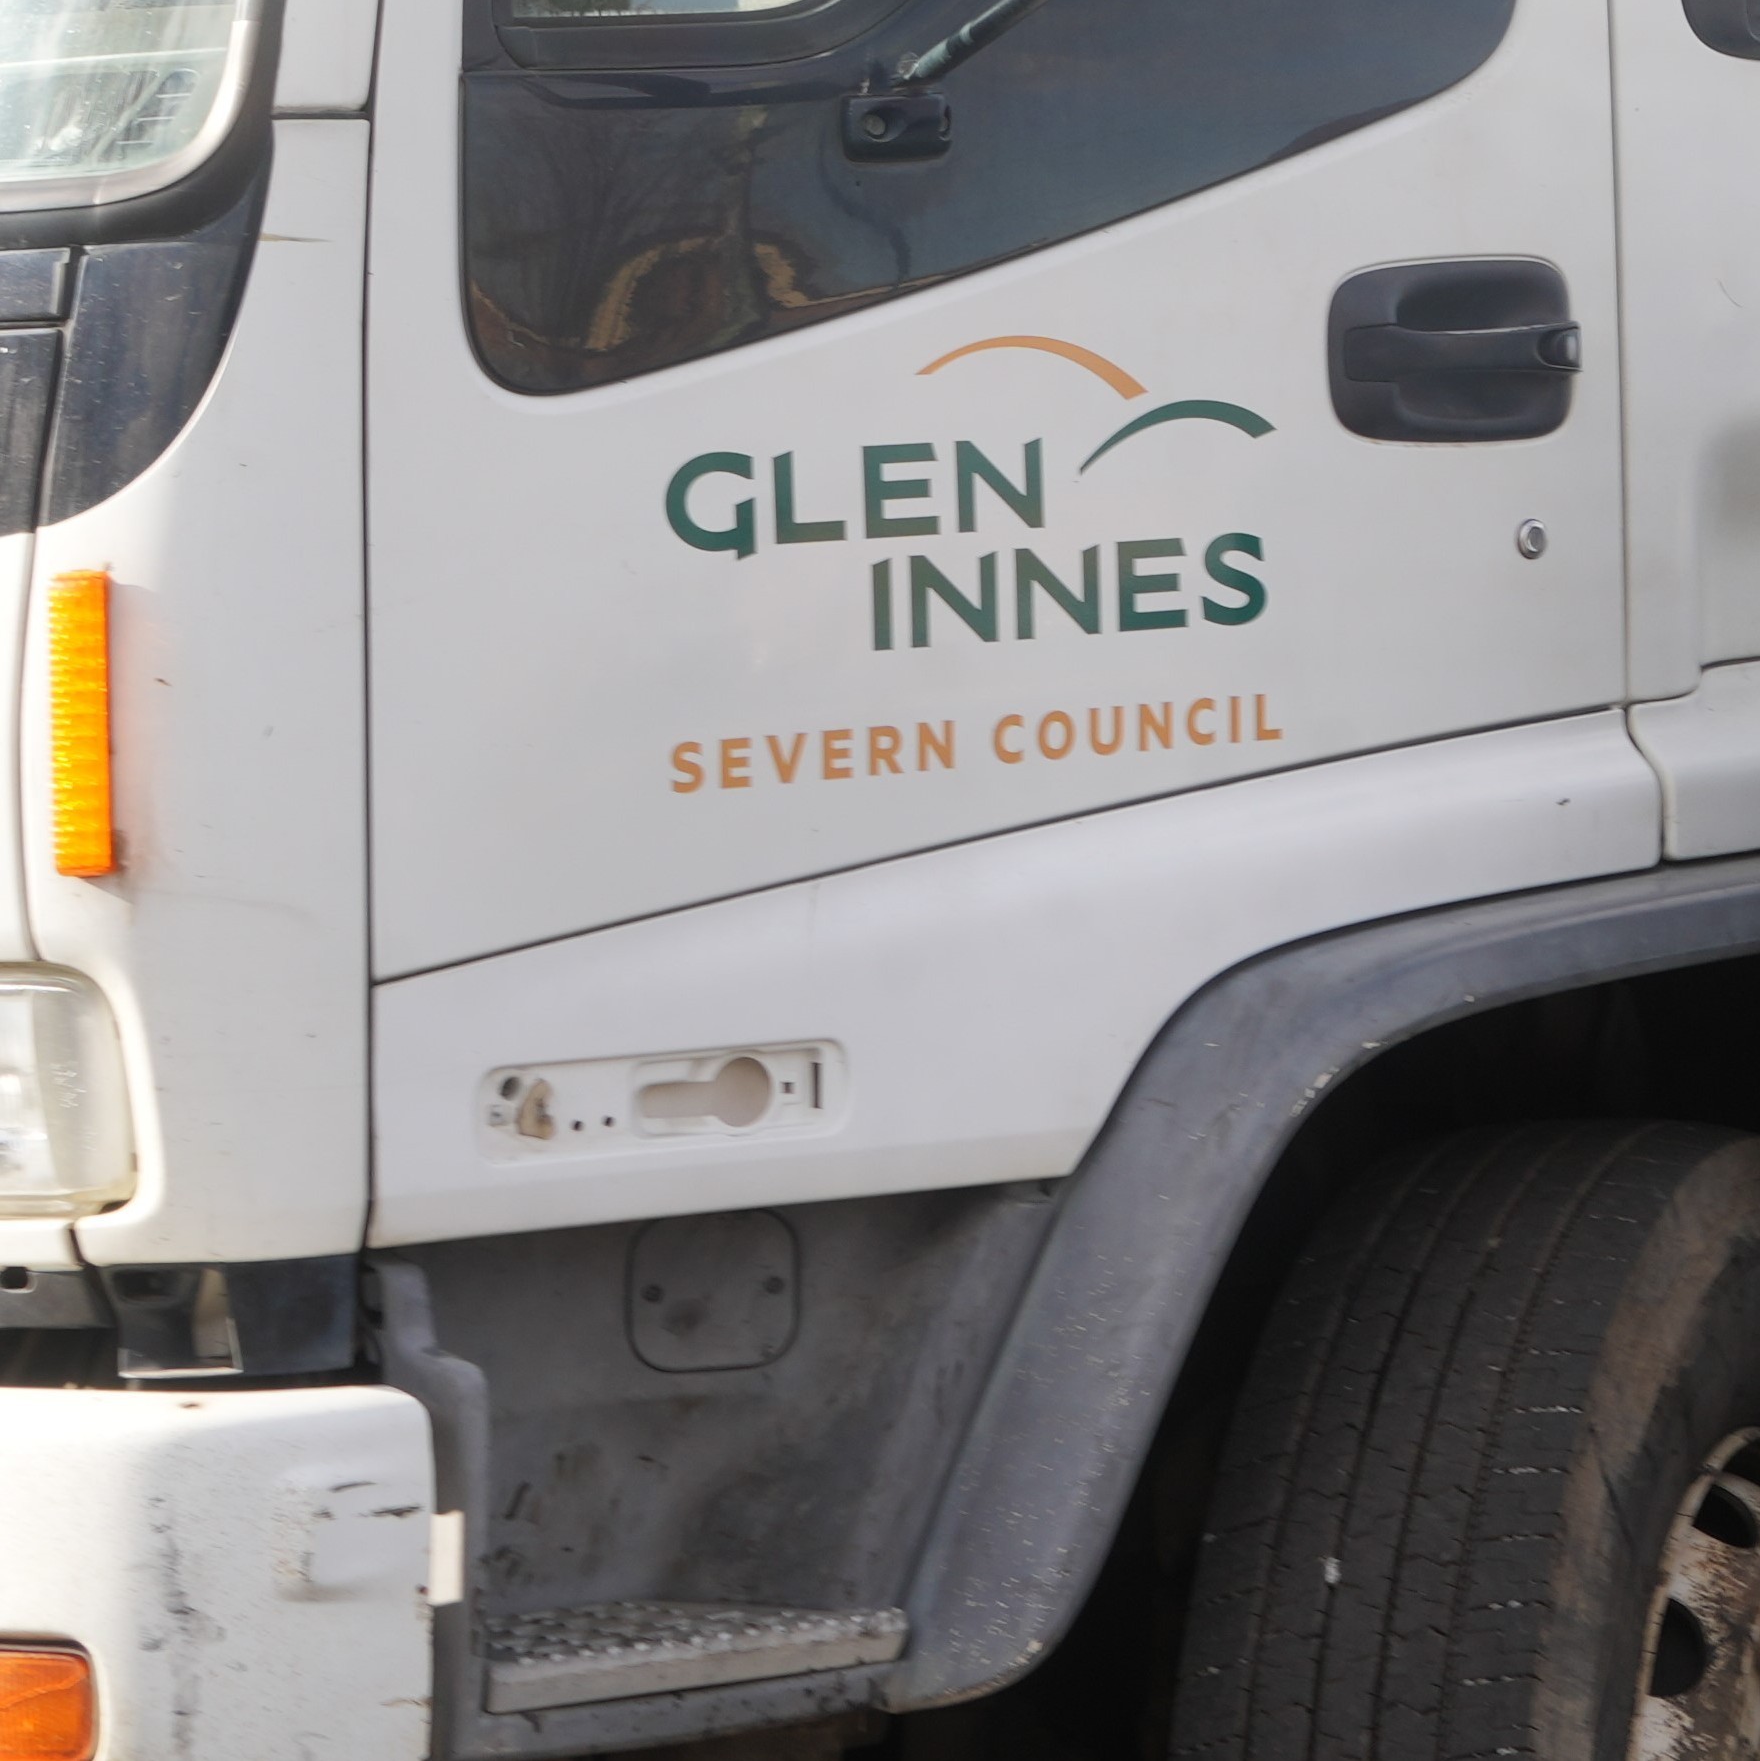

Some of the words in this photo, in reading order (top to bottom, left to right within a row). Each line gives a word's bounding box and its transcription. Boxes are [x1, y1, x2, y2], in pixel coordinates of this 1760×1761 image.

[665, 438, 1044, 559] GLEN
[872, 531, 1268, 652] INNES
[669, 718, 957, 794] SEVERN
[991, 693, 1283, 765] COUNCIL
